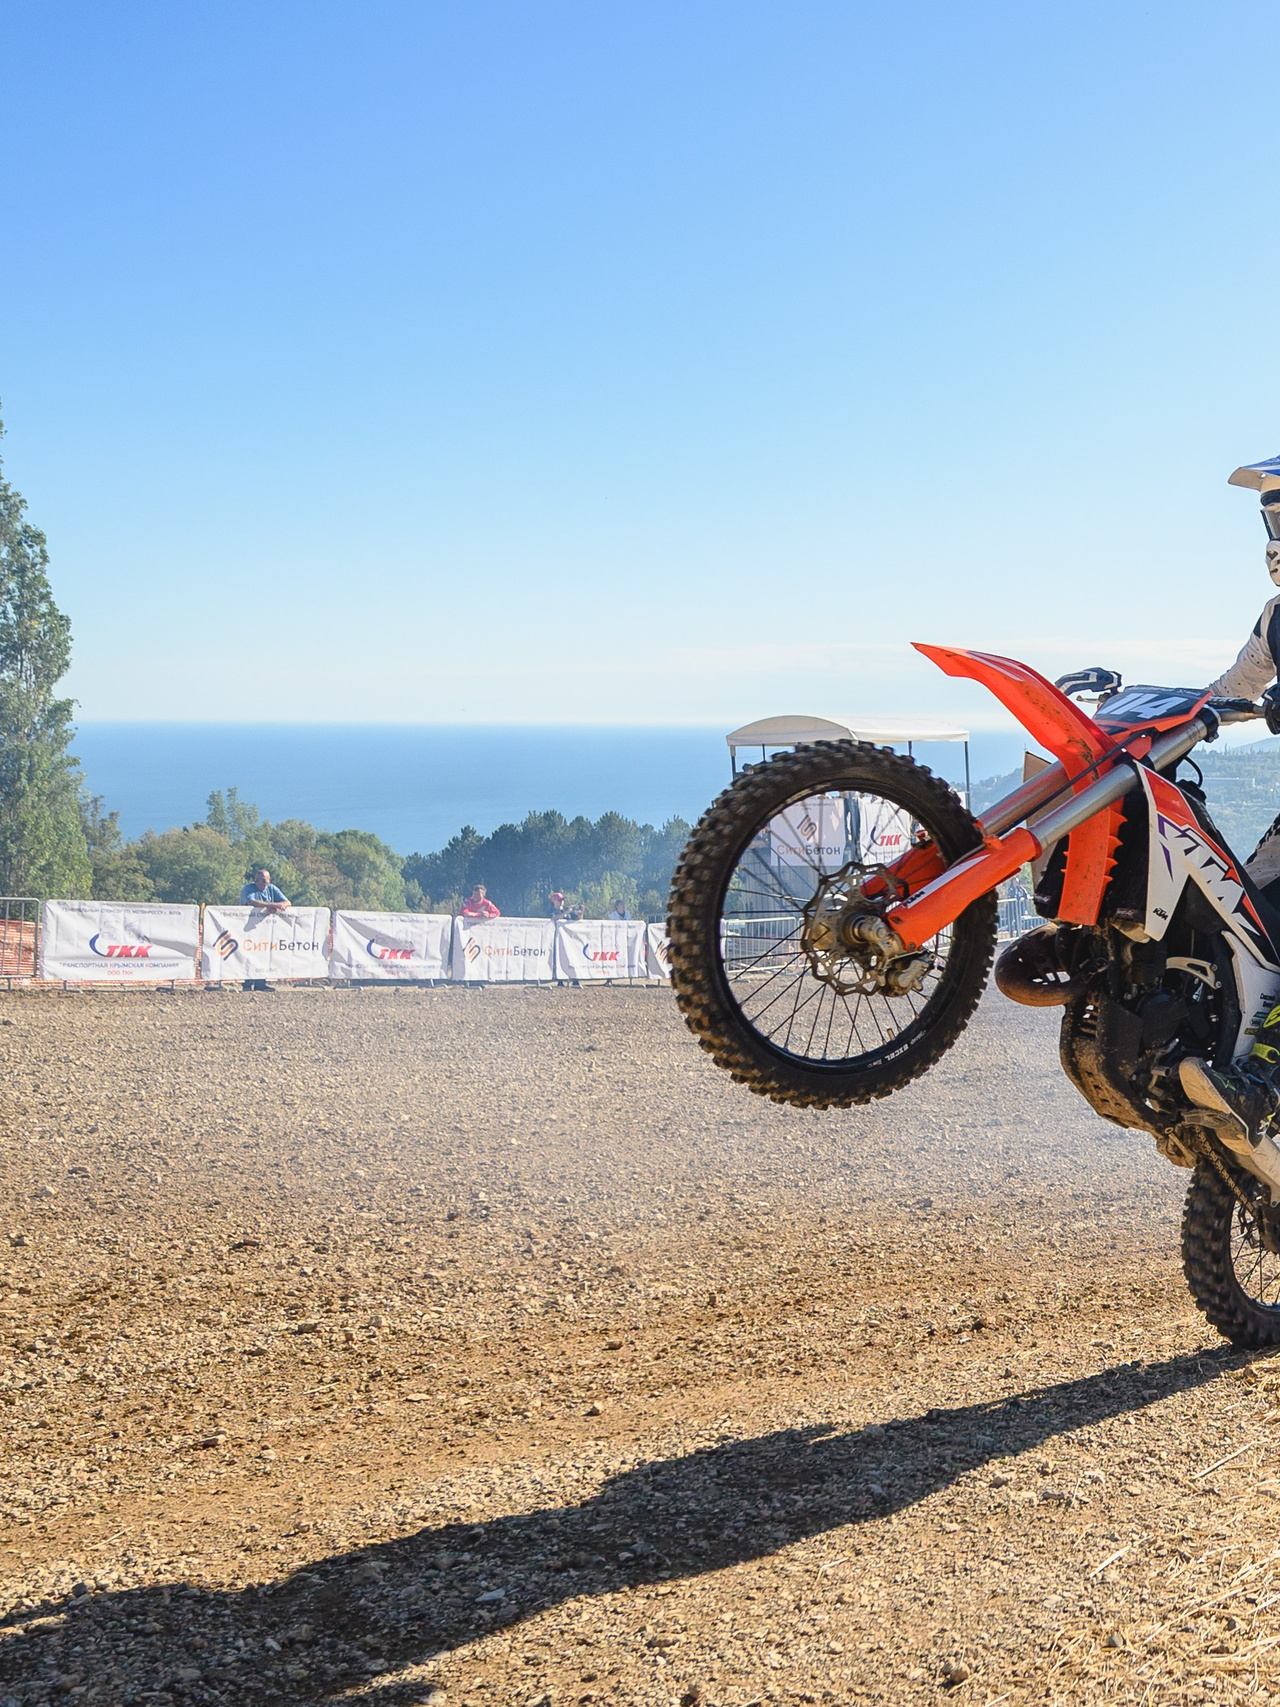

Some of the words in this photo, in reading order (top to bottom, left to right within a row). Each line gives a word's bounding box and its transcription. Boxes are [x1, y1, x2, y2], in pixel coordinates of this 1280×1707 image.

[1097, 692, 1189, 719] 114
[1152, 907, 1169, 921] KTM
[105, 945, 153, 958] ТКК
[242, 939, 319, 952] СитиБетон
[484, 945, 546, 957] СитиБетон
[380, 948, 416, 960] ТКК
[592, 951, 620, 962] ТКК
[884, 1043, 909, 1061] EXCEL
